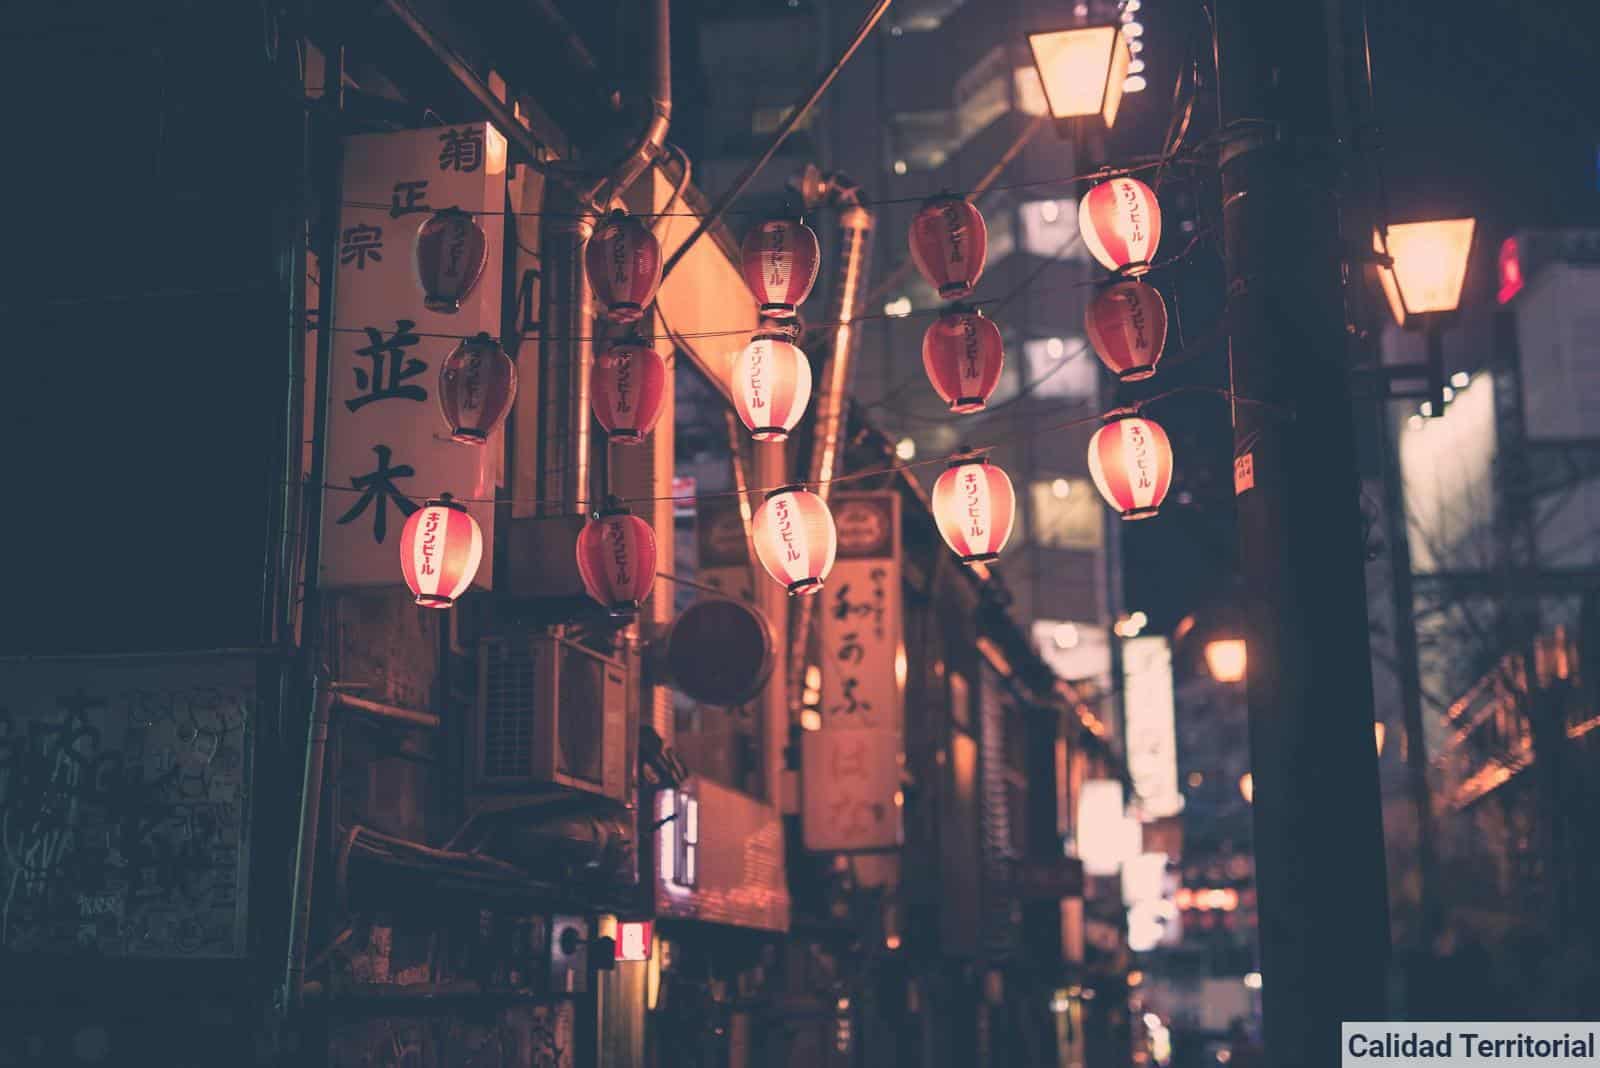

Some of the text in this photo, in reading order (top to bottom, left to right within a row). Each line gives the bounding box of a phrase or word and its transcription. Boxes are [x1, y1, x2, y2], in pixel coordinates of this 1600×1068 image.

[1120, 181, 1145, 243] キリンビール
[750, 346, 766, 410] キリンビール
[335, 318, 429, 545] 並木
[1130, 425, 1152, 490] キリンビール
[774, 499, 801, 563] キリンビール
[962, 472, 985, 537] キリンビール
[420, 512, 441, 577] キリンビール
